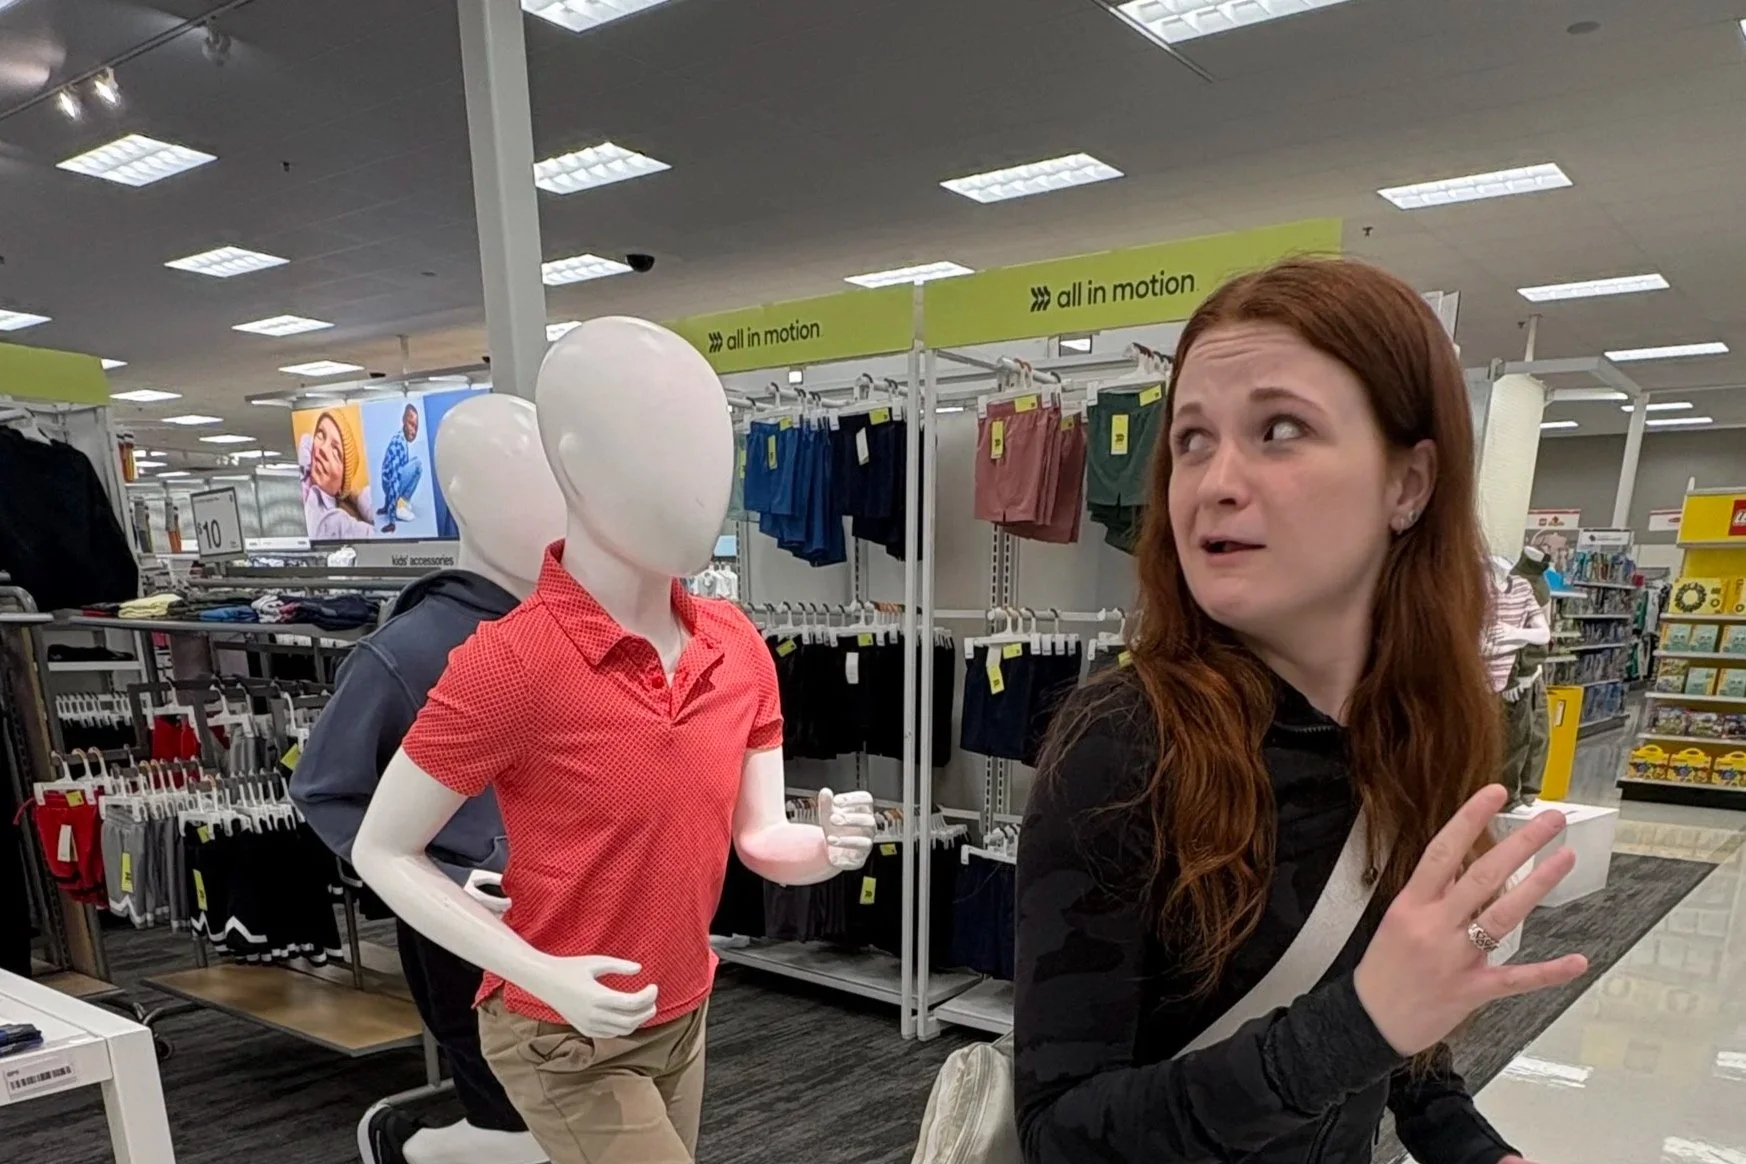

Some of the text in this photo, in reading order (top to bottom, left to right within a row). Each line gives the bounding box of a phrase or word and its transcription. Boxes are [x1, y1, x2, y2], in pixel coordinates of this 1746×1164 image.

[1057, 270, 1195, 308] all in motion
[726, 319, 820, 350] all in motion
[410, 555, 454, 566] accessories
